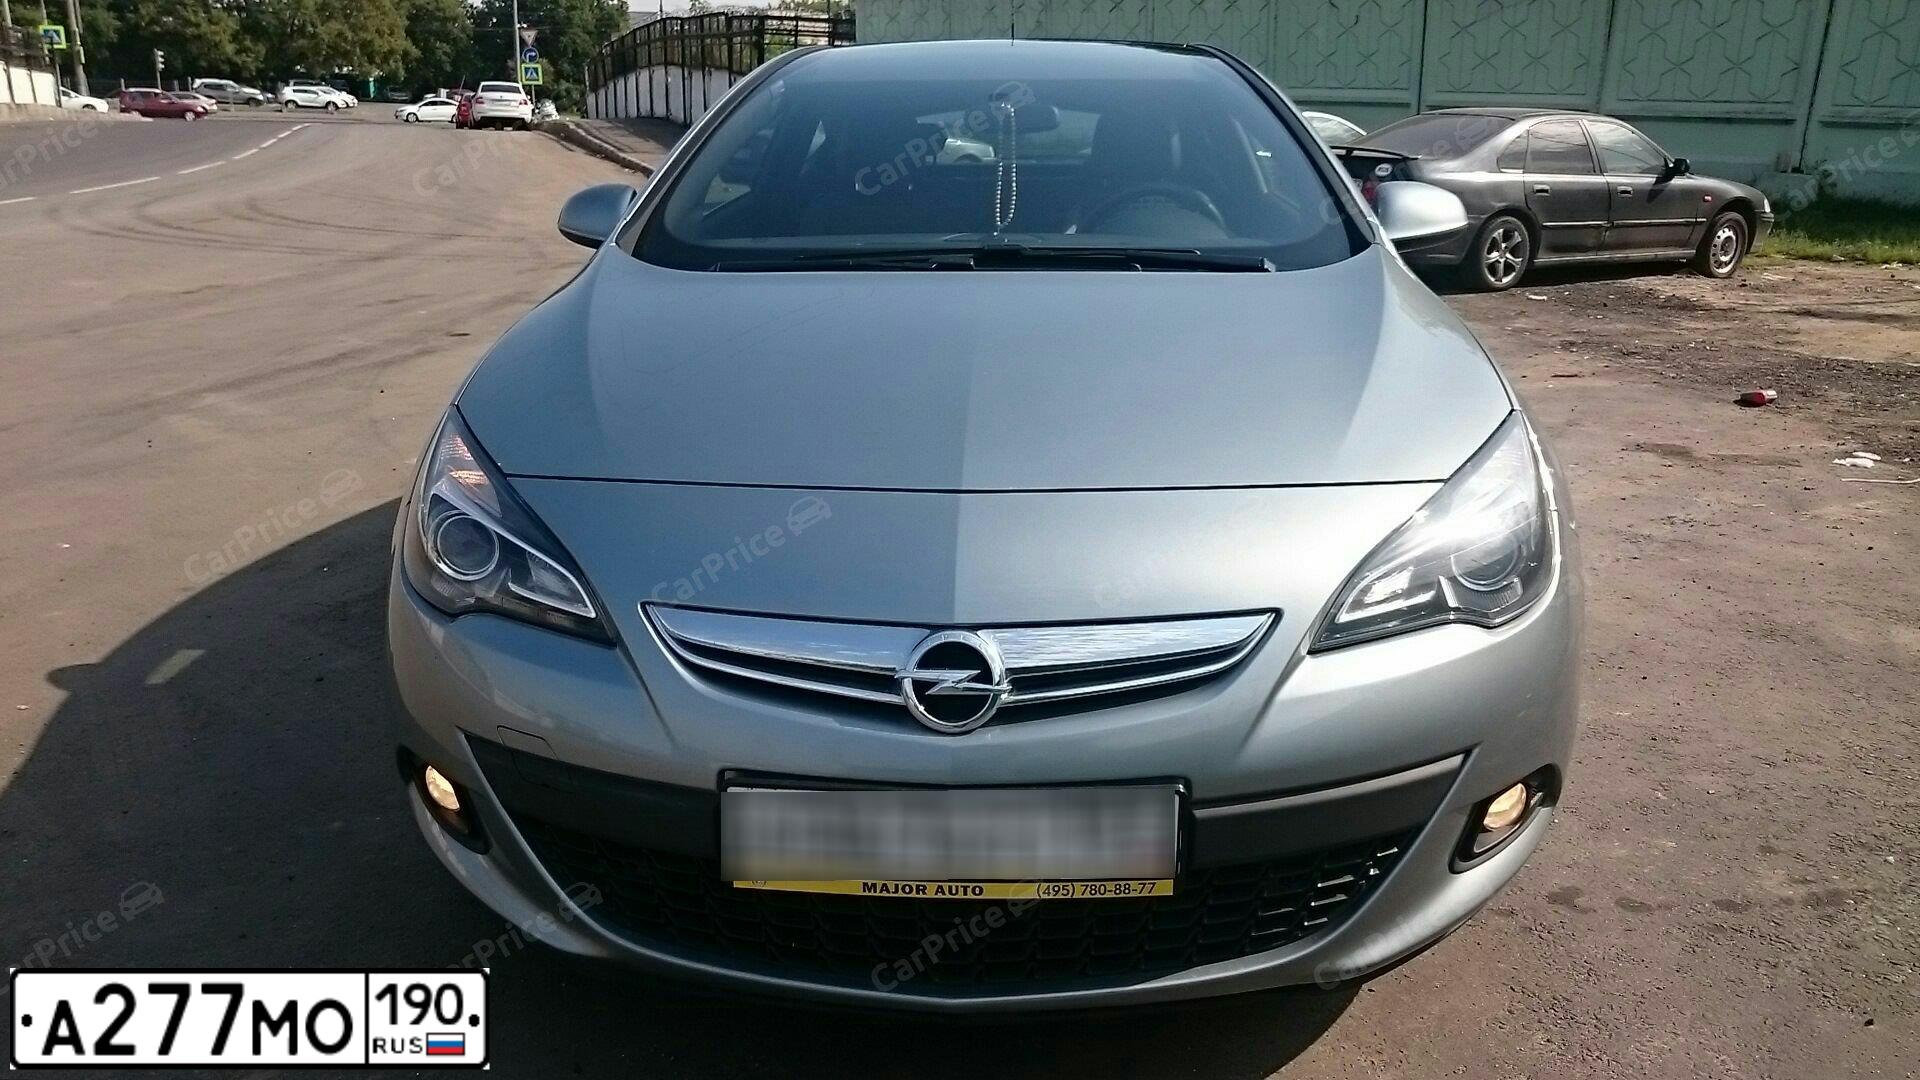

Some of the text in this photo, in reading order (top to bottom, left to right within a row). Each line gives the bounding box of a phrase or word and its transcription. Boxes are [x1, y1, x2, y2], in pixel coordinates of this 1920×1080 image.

[862, 881, 1157, 897] MAJOR AUTO (495) 780-88-77
